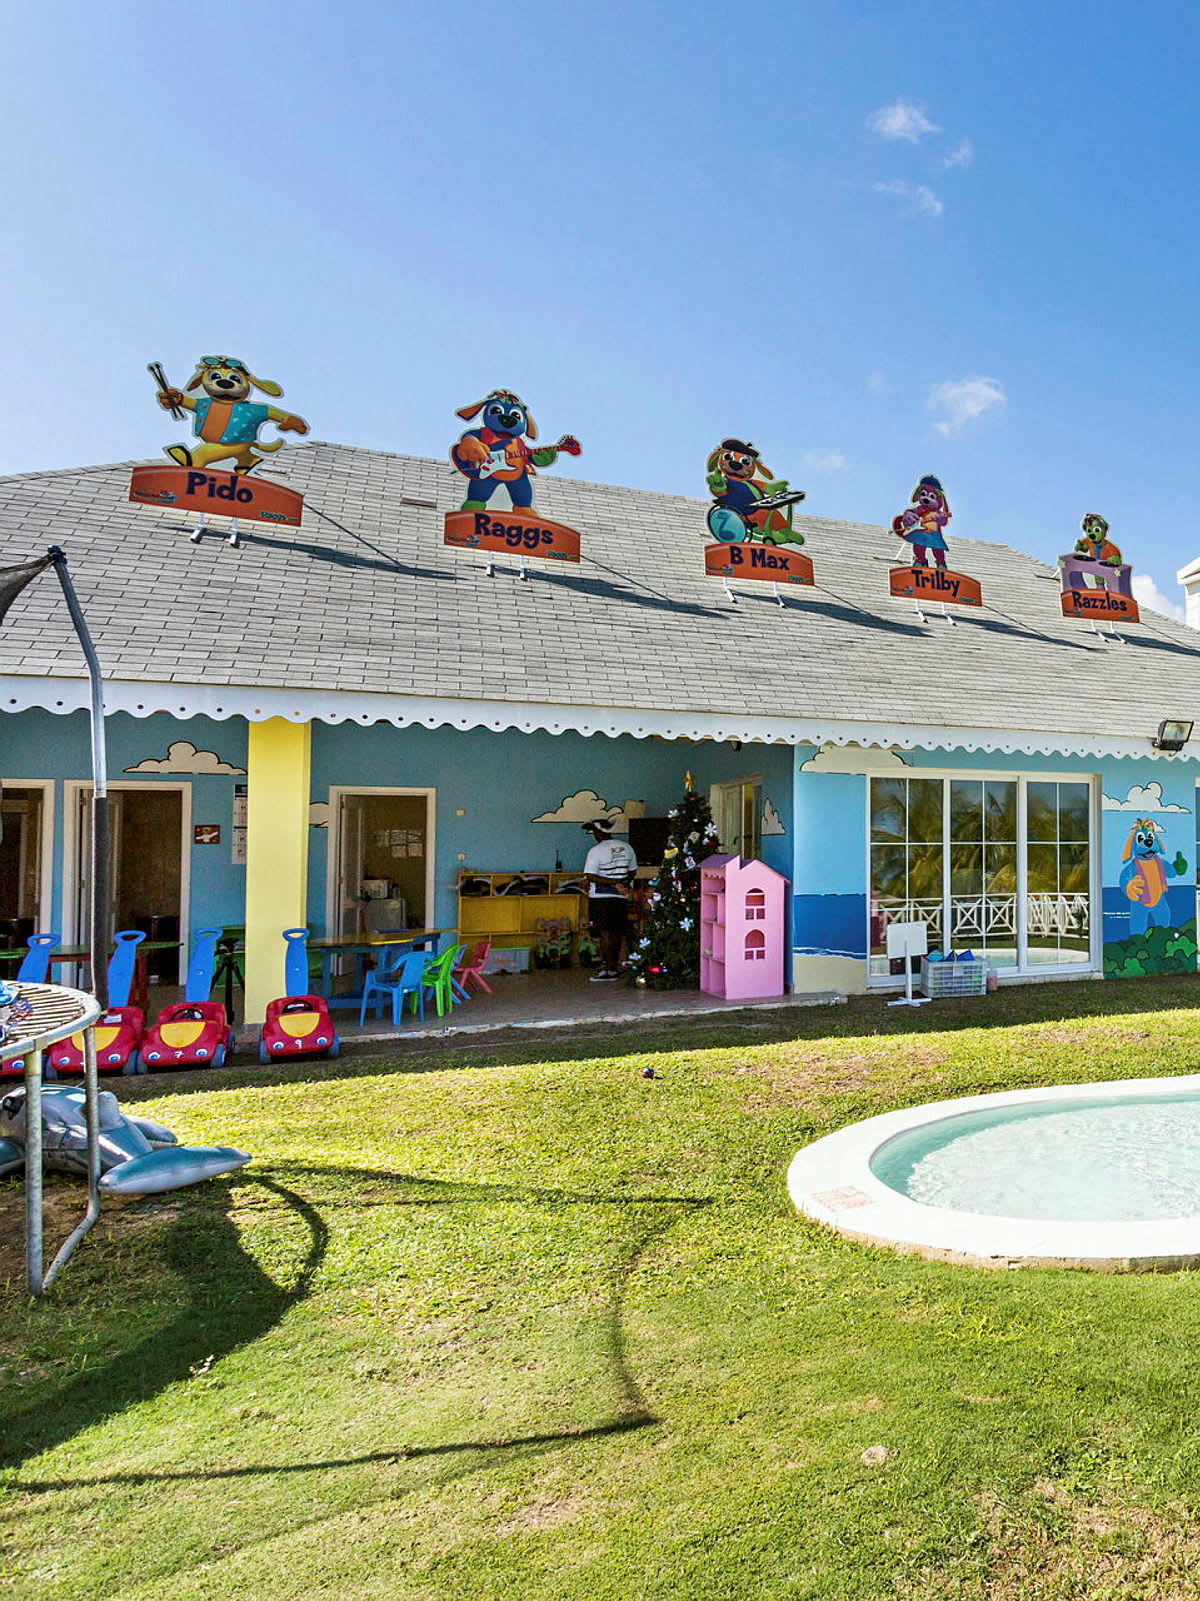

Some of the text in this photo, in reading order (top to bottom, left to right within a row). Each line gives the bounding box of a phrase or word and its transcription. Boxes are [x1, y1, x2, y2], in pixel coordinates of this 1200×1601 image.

[186, 472, 253, 503] Pido
[474, 513, 554, 549] Raggs
[729, 546, 744, 565] B
[750, 548, 790, 570] Max
[911, 569, 960, 597] Trilby
[1072, 591, 1127, 611] Razzles
[294, 1039, 303, 1050] 9
